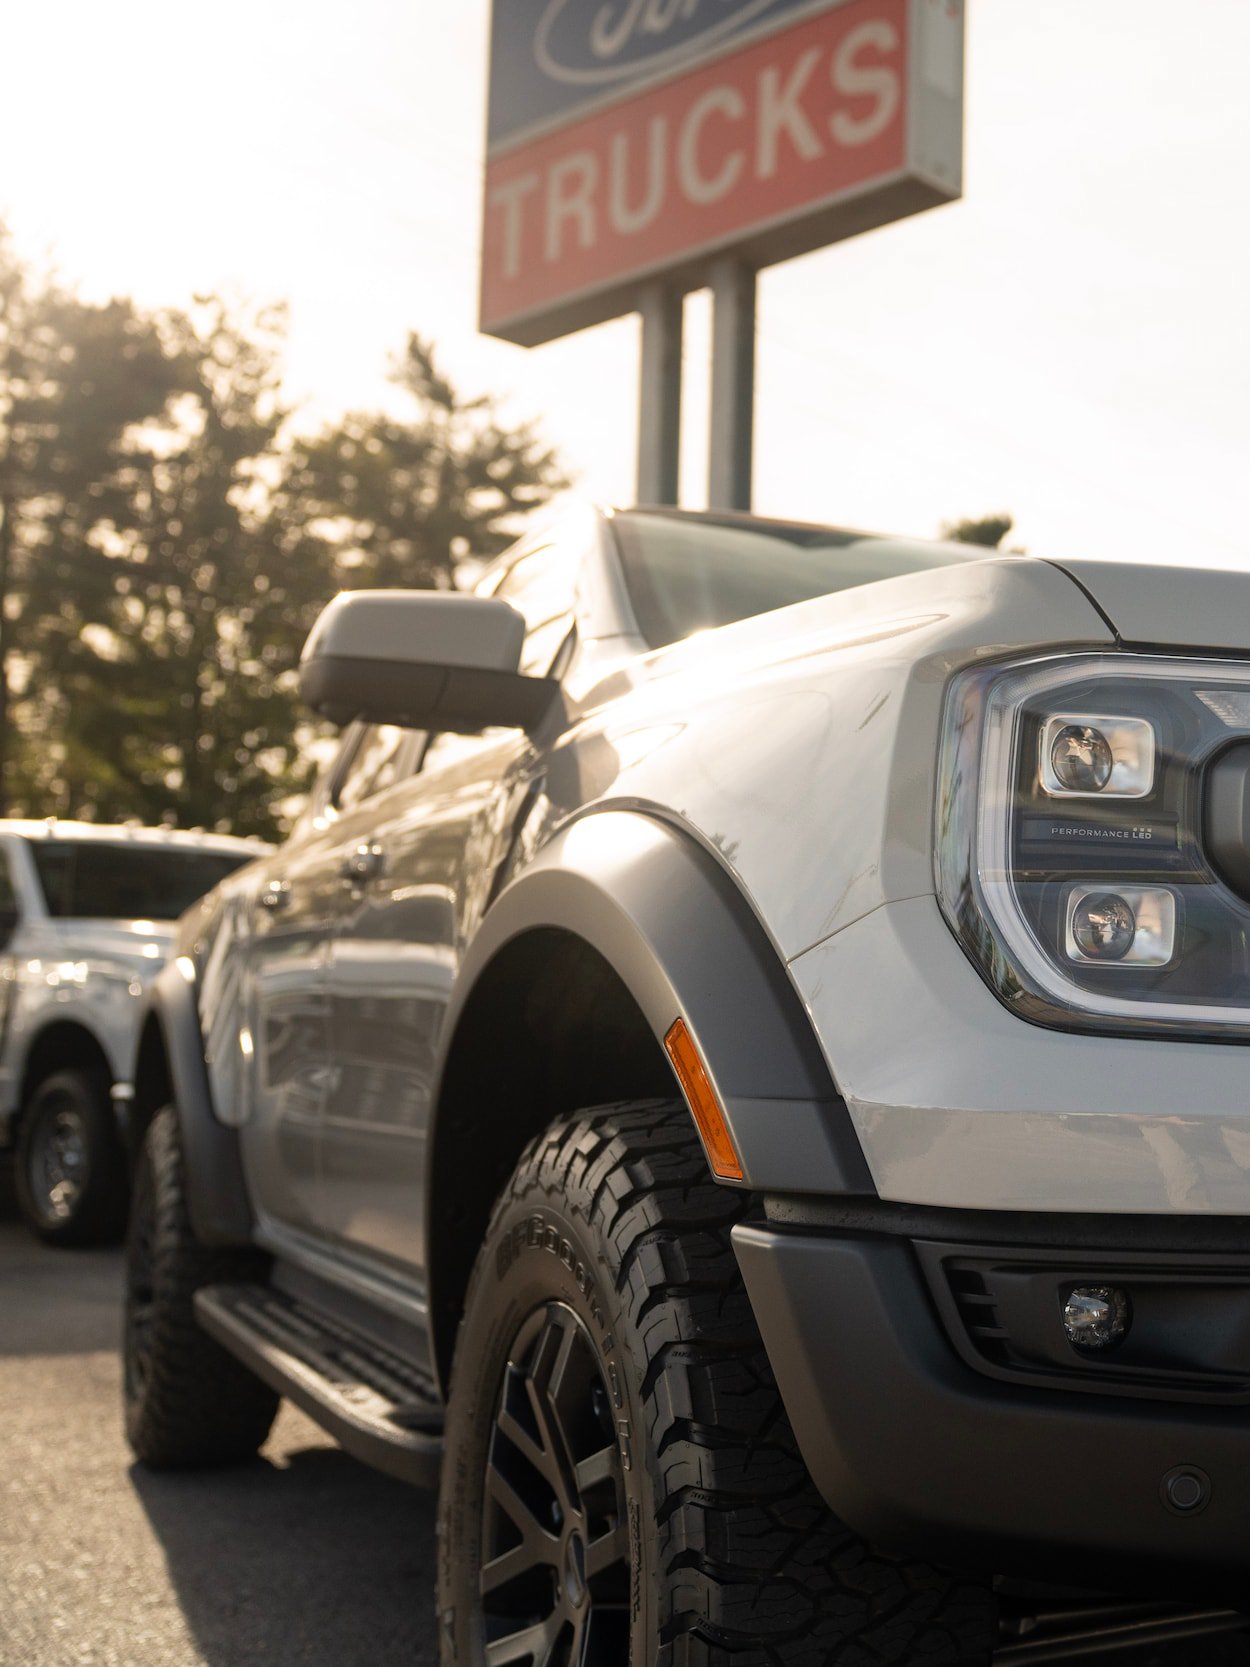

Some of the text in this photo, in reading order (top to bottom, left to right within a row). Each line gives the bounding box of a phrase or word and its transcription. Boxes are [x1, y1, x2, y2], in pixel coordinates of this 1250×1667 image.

[488, 20, 900, 279] TRUCKS
[1051, 827, 1152, 840] PERFORMANCE LED
